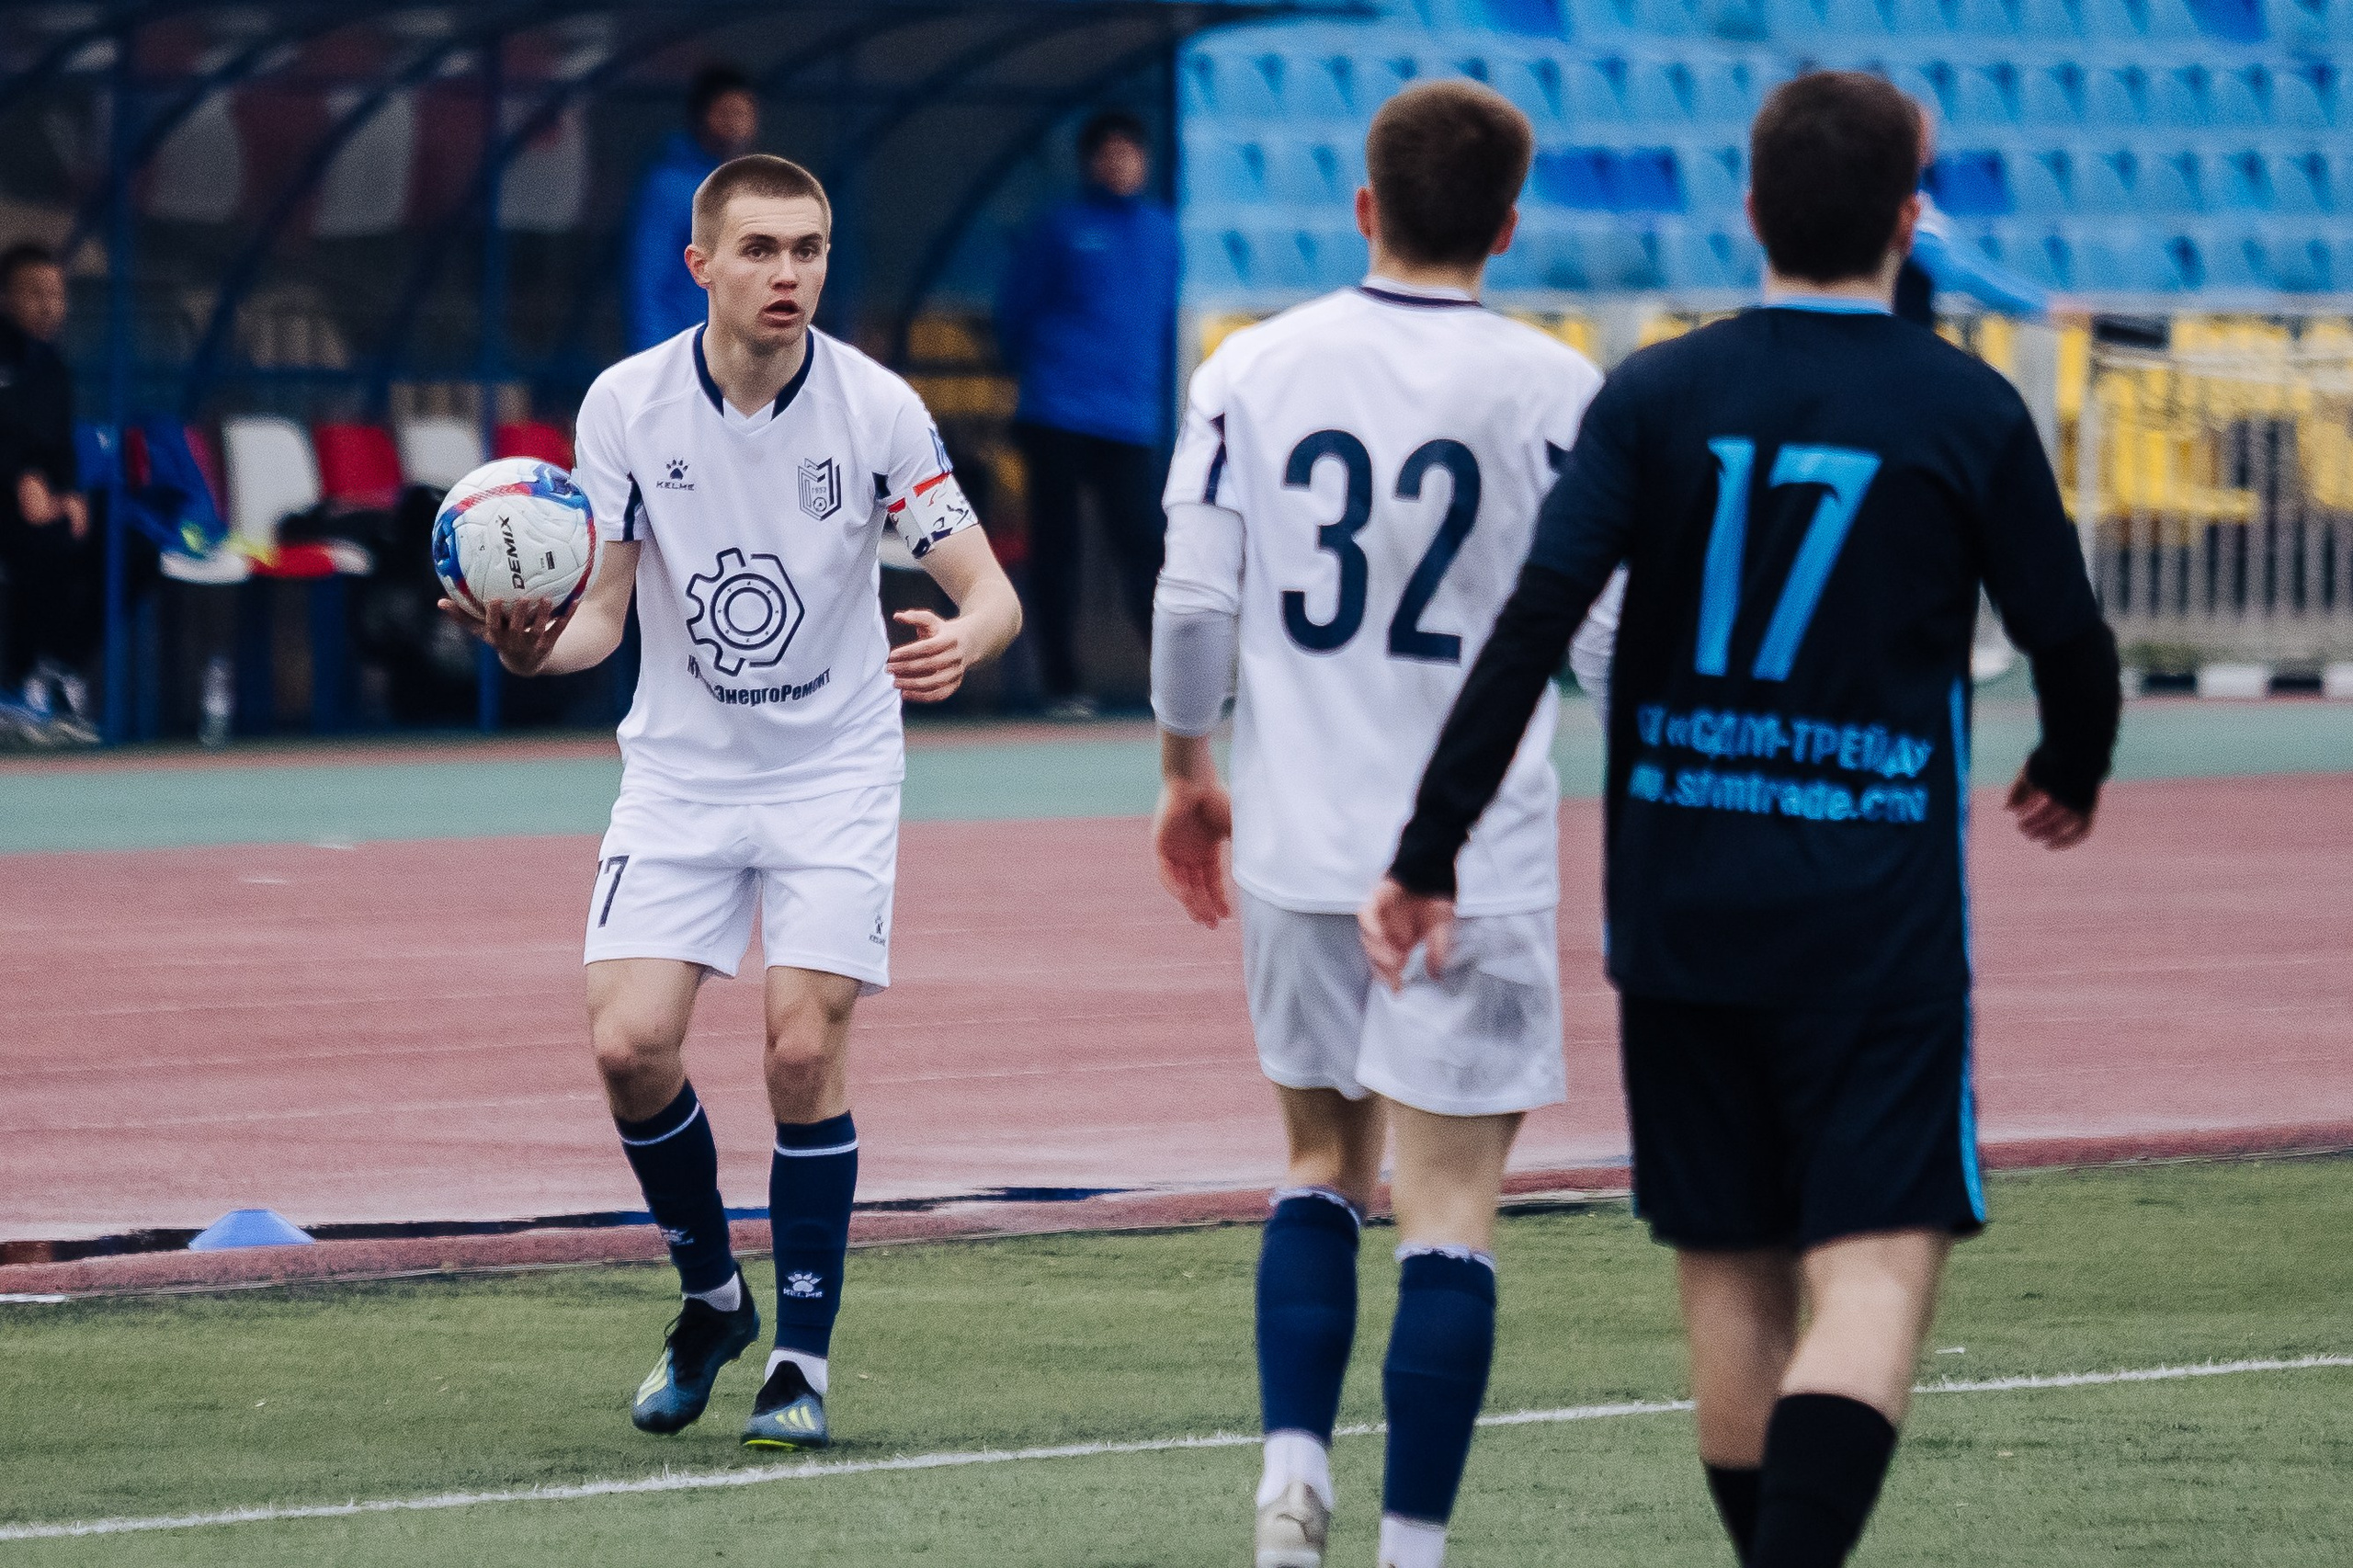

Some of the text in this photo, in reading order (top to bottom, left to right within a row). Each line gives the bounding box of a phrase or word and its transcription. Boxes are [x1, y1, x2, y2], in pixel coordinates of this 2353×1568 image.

[498, 515, 525, 589] DEMIX
[656, 481, 695, 491] KELME
[1280, 429, 1482, 665] 32
[1696, 437, 1882, 681] 17
